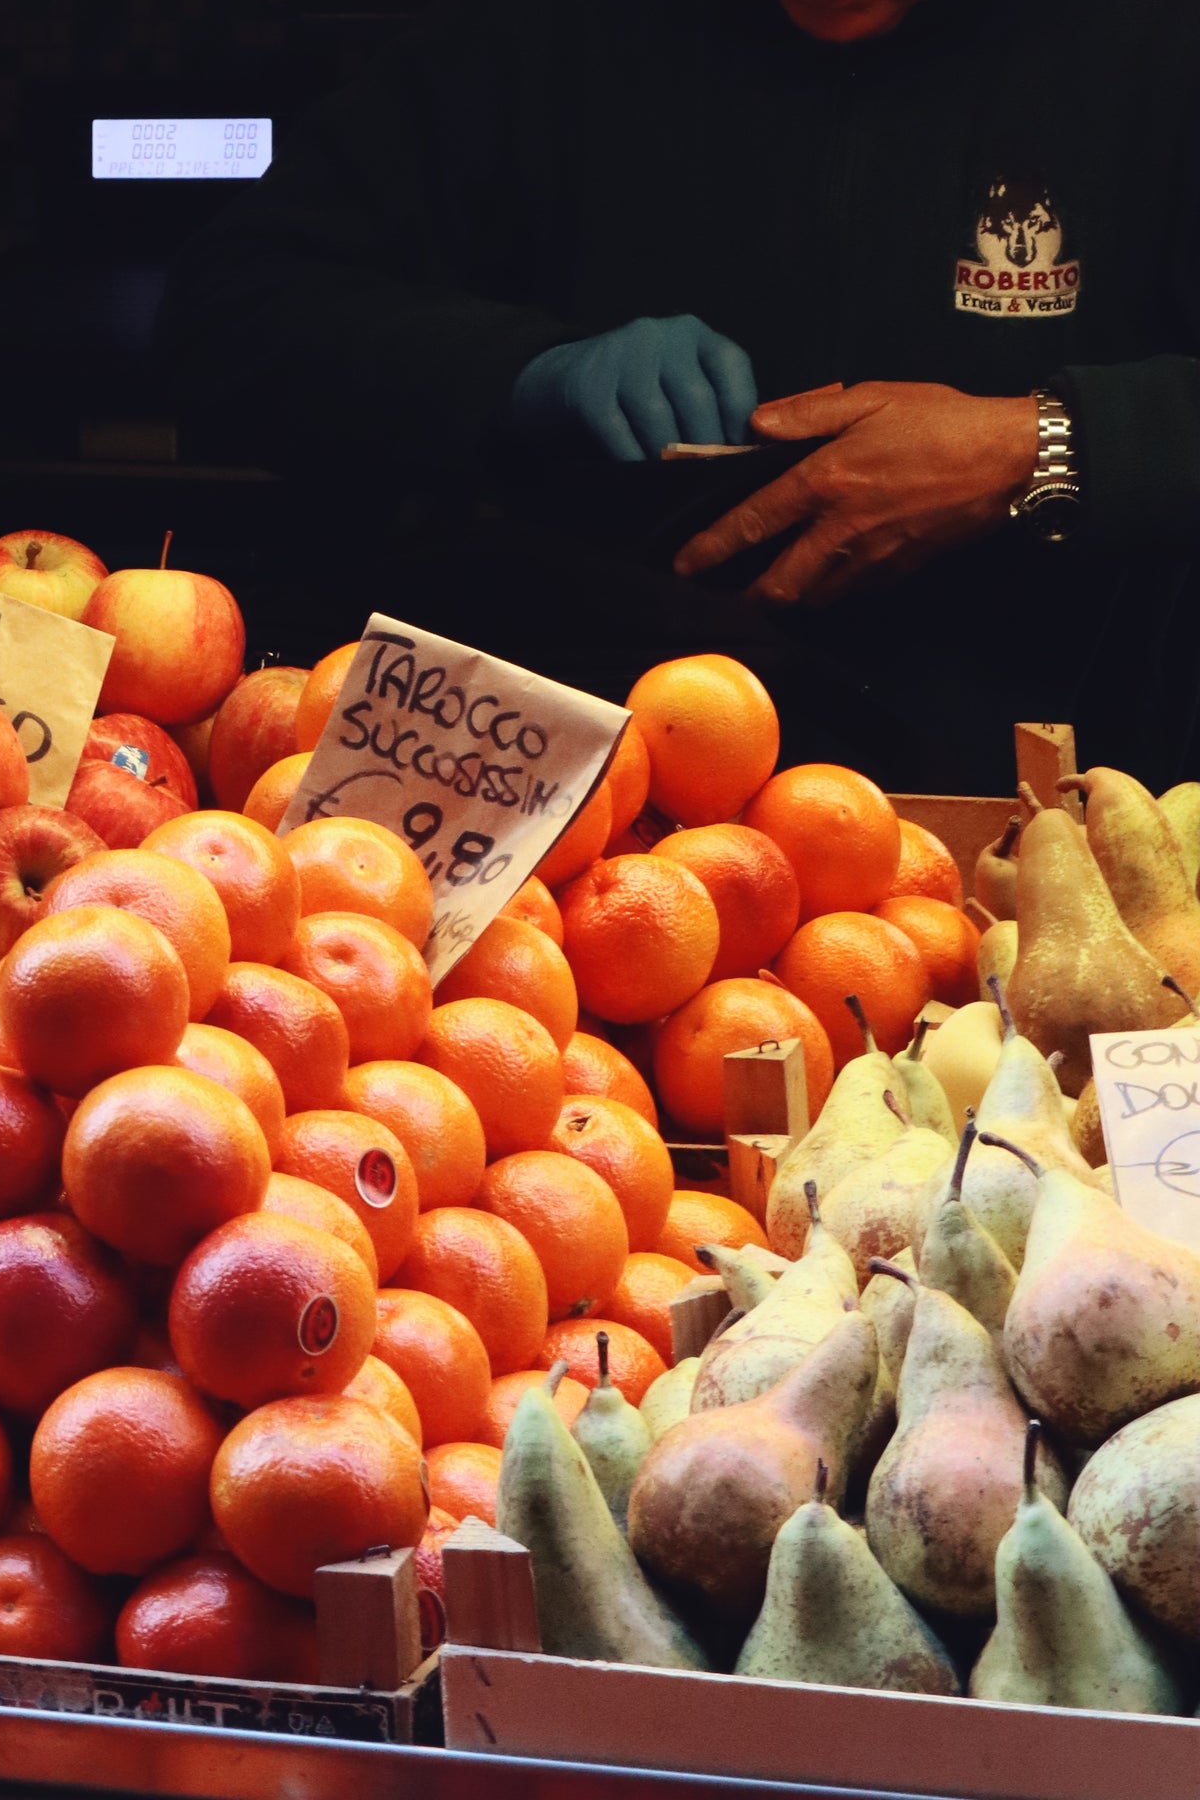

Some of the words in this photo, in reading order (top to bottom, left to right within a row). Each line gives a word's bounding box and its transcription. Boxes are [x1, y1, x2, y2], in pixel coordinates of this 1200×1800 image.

[957, 265, 1079, 291] ROBERTO
[1007, 299, 1020, 313] &
[364, 631, 547, 759] TAROCCO
